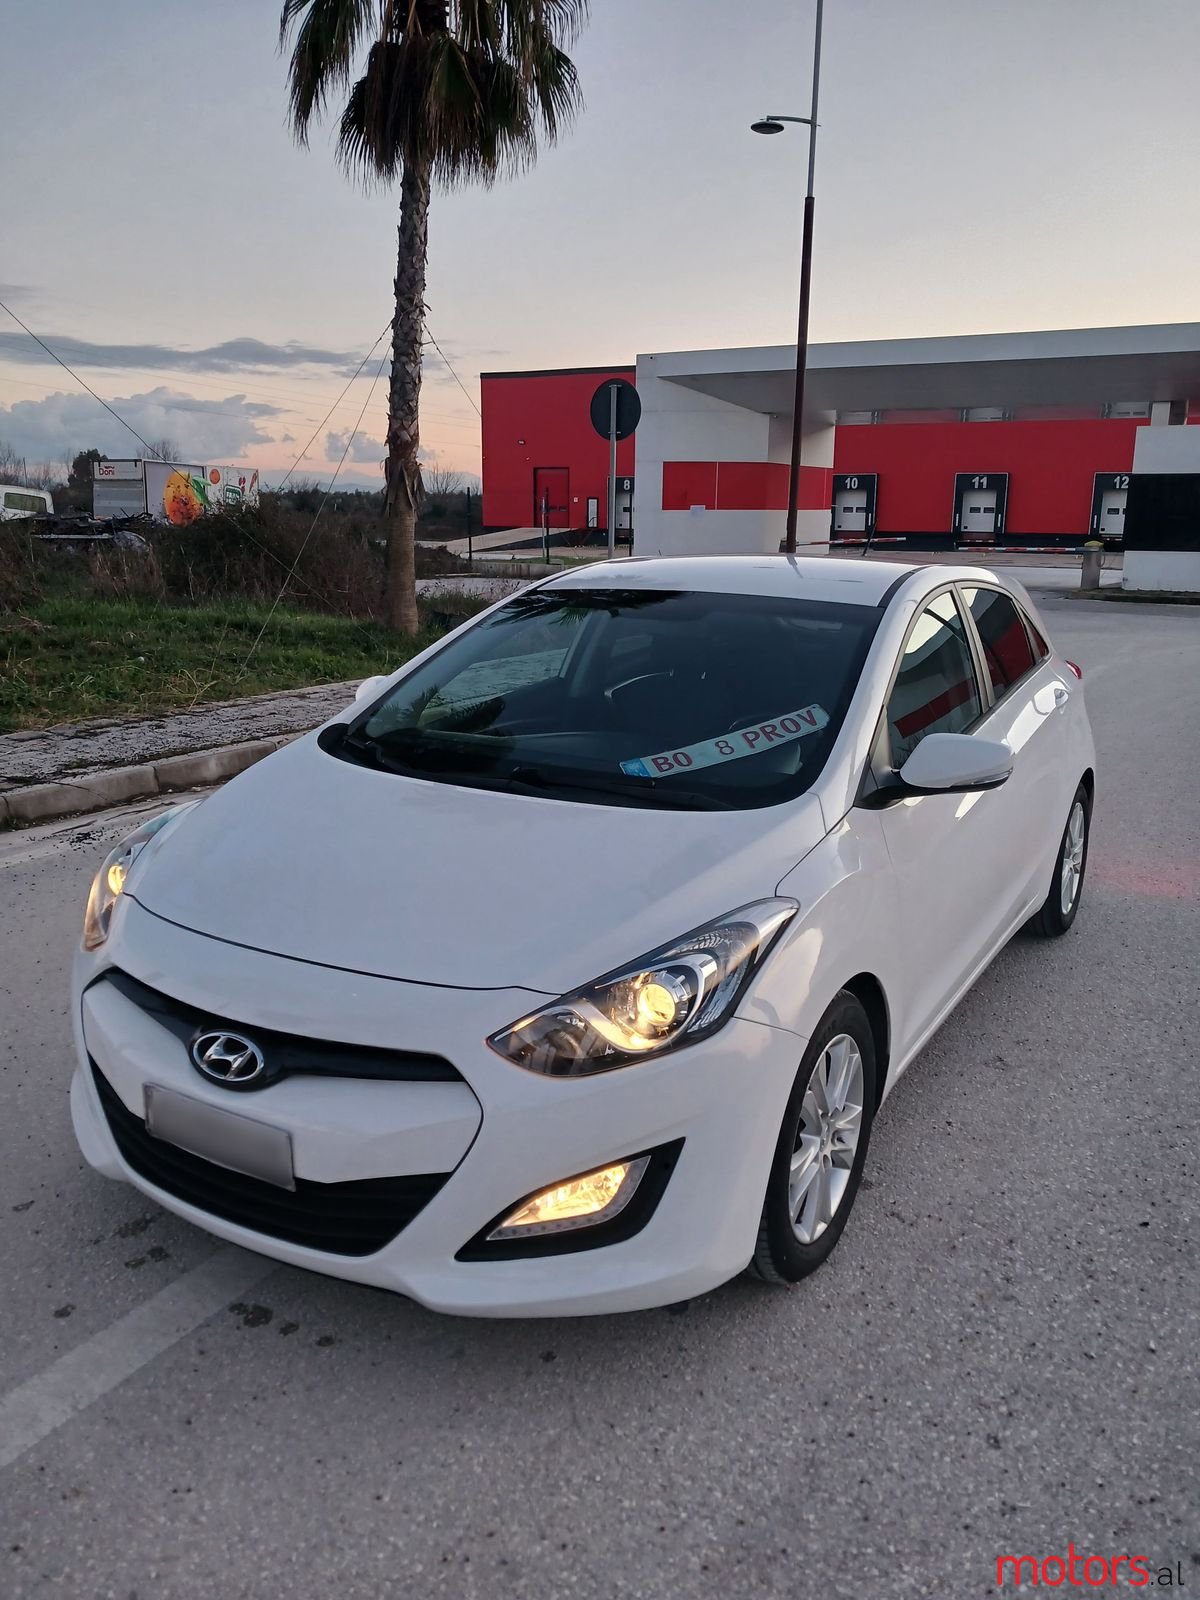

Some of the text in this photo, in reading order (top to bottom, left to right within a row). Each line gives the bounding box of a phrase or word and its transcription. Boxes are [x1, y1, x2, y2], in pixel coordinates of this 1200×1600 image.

[623, 479, 631, 490] 8
[845, 477, 858, 489] 10
[972, 476, 988, 489] 11
[1114, 475, 1130, 489] 12
[714, 740, 735, 756] 8
[741, 709, 818, 749] PROV
